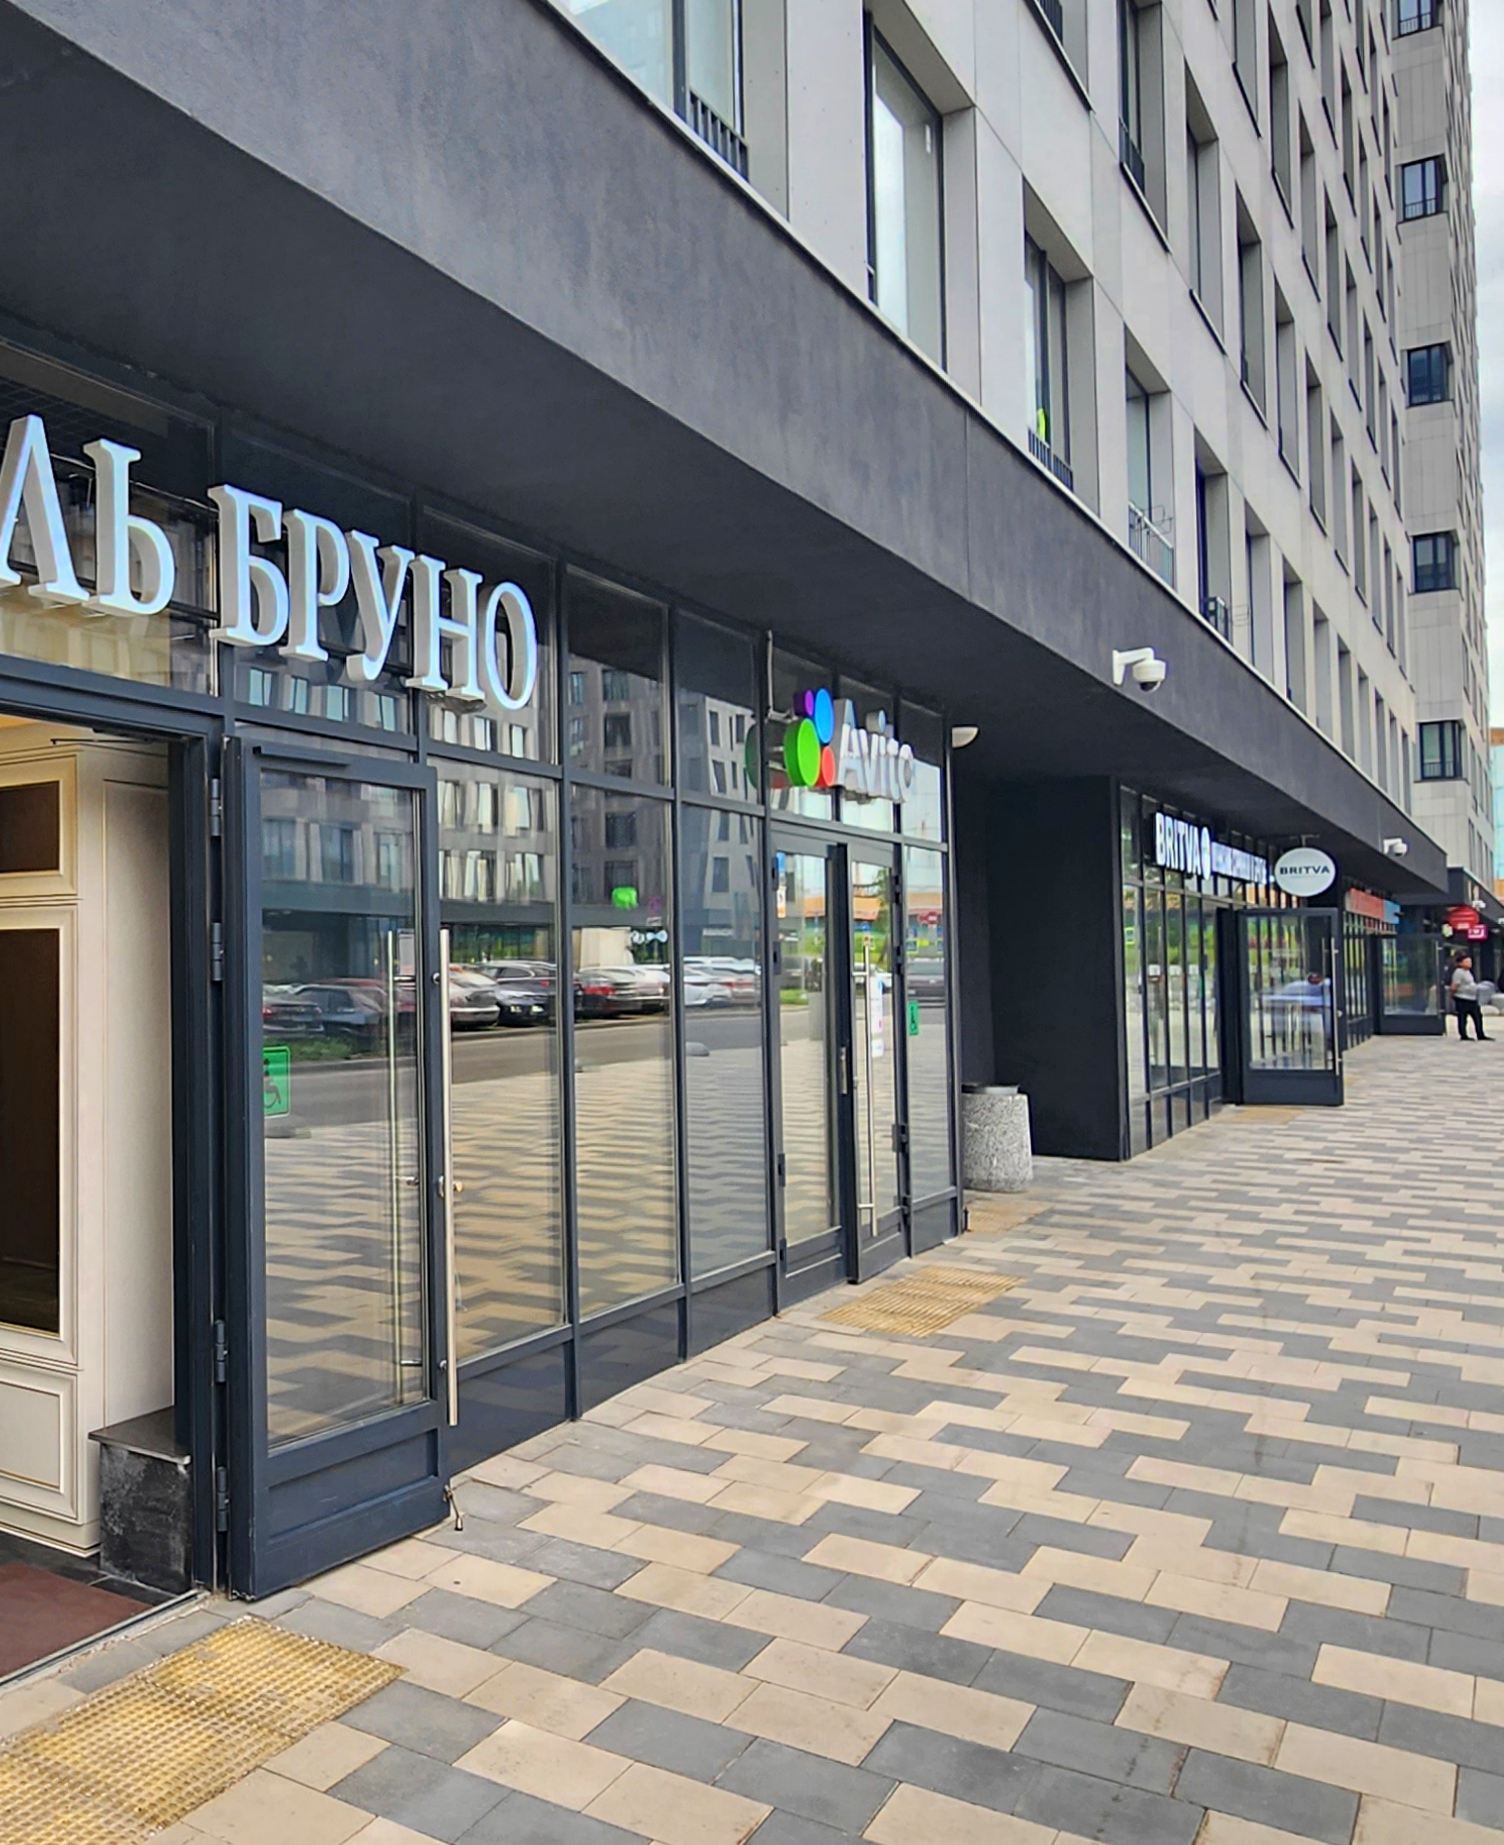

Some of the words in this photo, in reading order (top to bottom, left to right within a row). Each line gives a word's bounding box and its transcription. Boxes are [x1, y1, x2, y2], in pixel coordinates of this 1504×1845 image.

[207, 484, 537, 710] БРУНО
[834, 699, 914, 803] Avito
[1156, 812, 1201, 876] BRITVA
[1280, 866, 1330, 875] BRITVA
